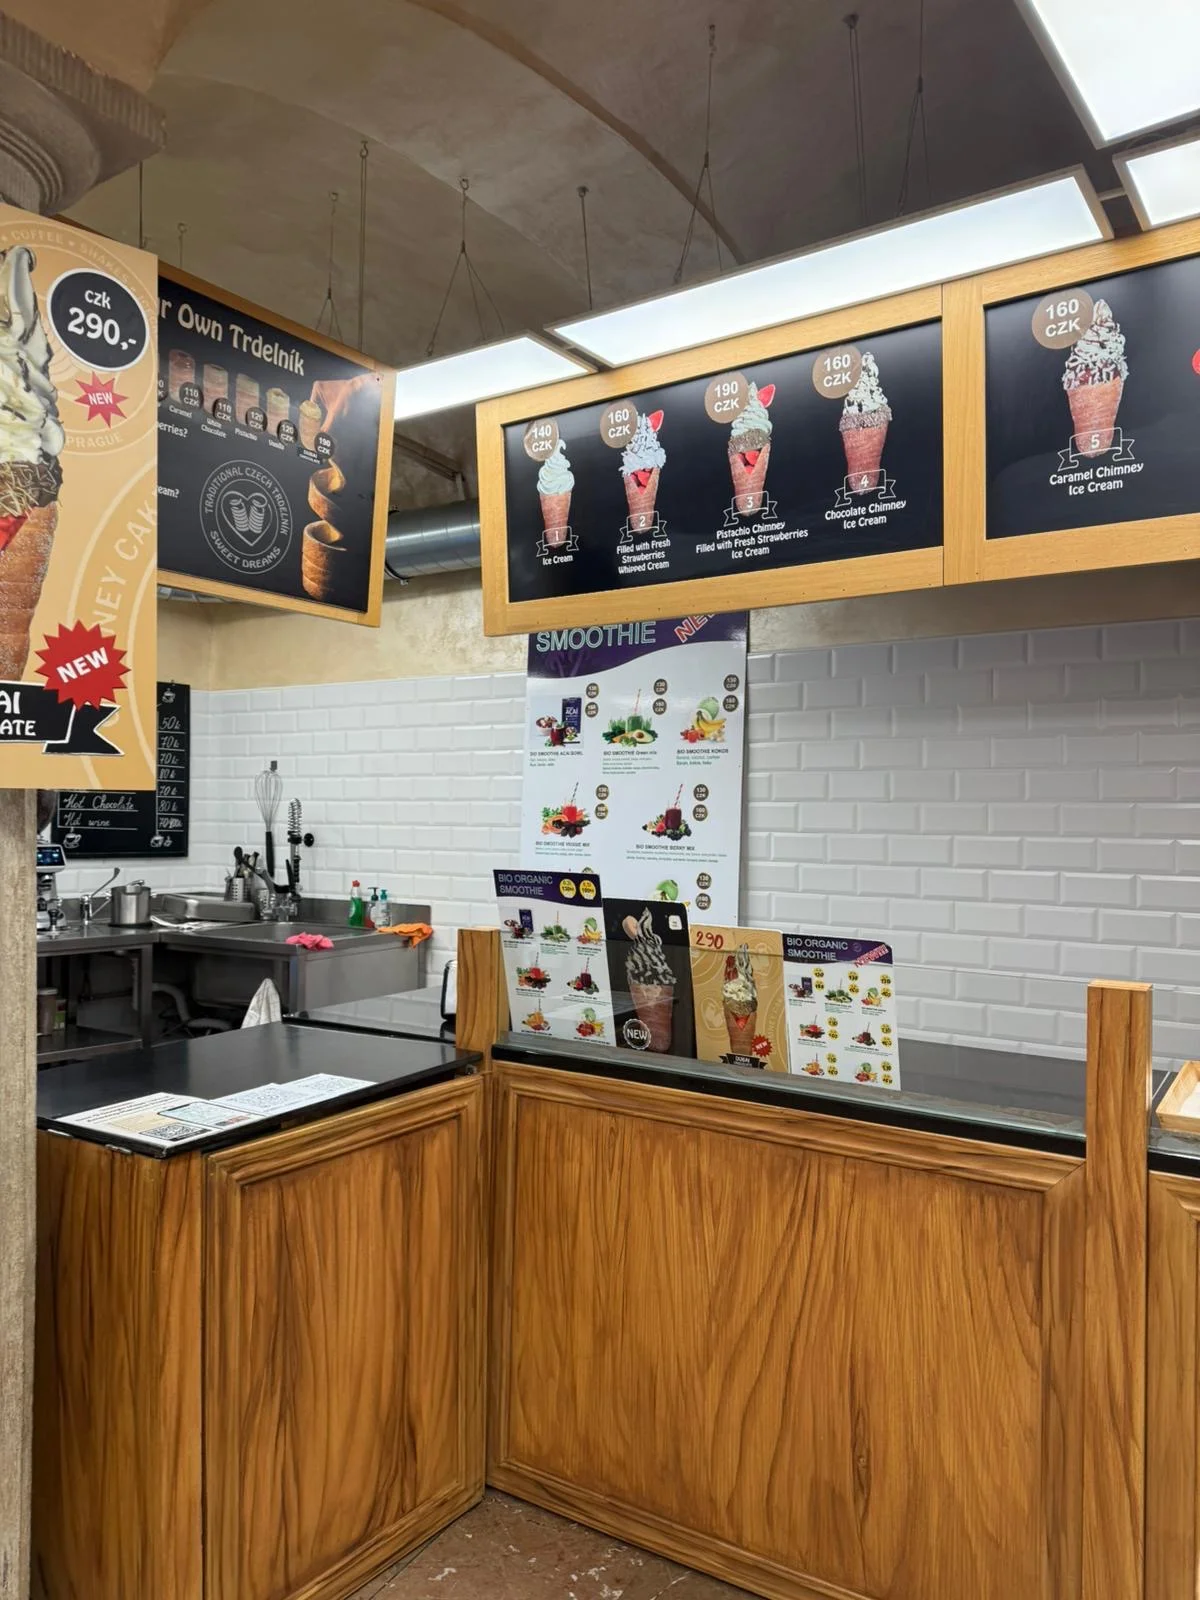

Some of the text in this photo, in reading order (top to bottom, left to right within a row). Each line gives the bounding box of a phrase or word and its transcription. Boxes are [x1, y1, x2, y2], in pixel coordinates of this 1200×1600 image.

[84, 289, 111, 310] czk
[1046, 299, 1079, 319] 160
[67, 306, 137, 350] 290,-
[1045, 317, 1081, 338] CZK
[177, 303, 223, 342] Own
[229, 323, 304, 376] Trdelník
[823, 353, 851, 371] 160
[823, 371, 852, 388] CZK
[184, 387, 199, 398] 110
[714, 380, 739, 398] 190
[87, 392, 113, 406] NEW
[183, 396, 200, 407] CZK
[714, 399, 740, 413] CZK
[218, 402, 232, 414] 110
[216, 411, 232, 422] CZK
[608, 408, 630, 424] 160
[532, 424, 552, 439] 140
[608, 425, 631, 439] CZK
[66, 432, 123, 449] PRAGUE
[531, 440, 553, 453] CZK
[1090, 433, 1100, 449] 5
[860, 474, 869, 488] 4
[1049, 462, 1144, 486] Caramel Chimney
[204, 466, 243, 514] TRADITIONAL
[244, 467, 273, 489] CZECH
[1069, 479, 1123, 496] Ice Cream
[745, 497, 753, 509] 3
[824, 500, 906, 521] Chocolate Chimney
[639, 515, 646, 527] 2
[843, 515, 887, 530] Ice Cream
[555, 530, 559, 541] 1
[716, 521, 786, 540] Pistachio Chimney
[616, 538, 671, 555] Filled with Fresh
[696, 529, 809, 554] Filled with Fresh Strawberries
[210, 530, 281, 569] SWEET DREAMS
[731, 546, 770, 560] Ice Cream
[542, 554, 573, 566] Ice Cream
[621, 551, 666, 564] Strawberries
[618, 561, 670, 574] Whipped Cream
[535, 613, 716, 652] SMOOTHIE NE
[56, 647, 109, 683] NEW
[63, 793, 135, 810] Hot Chocolate
[498, 874, 553, 885] BIO ORGANIC
[500, 885, 545, 896] SMOOTHIE
[696, 931, 724, 949] 290
[786, 937, 849, 950] BIO ORGANIC
[787, 948, 837, 960] SMOOTHIE
[627, 1028, 648, 1040] NEW
